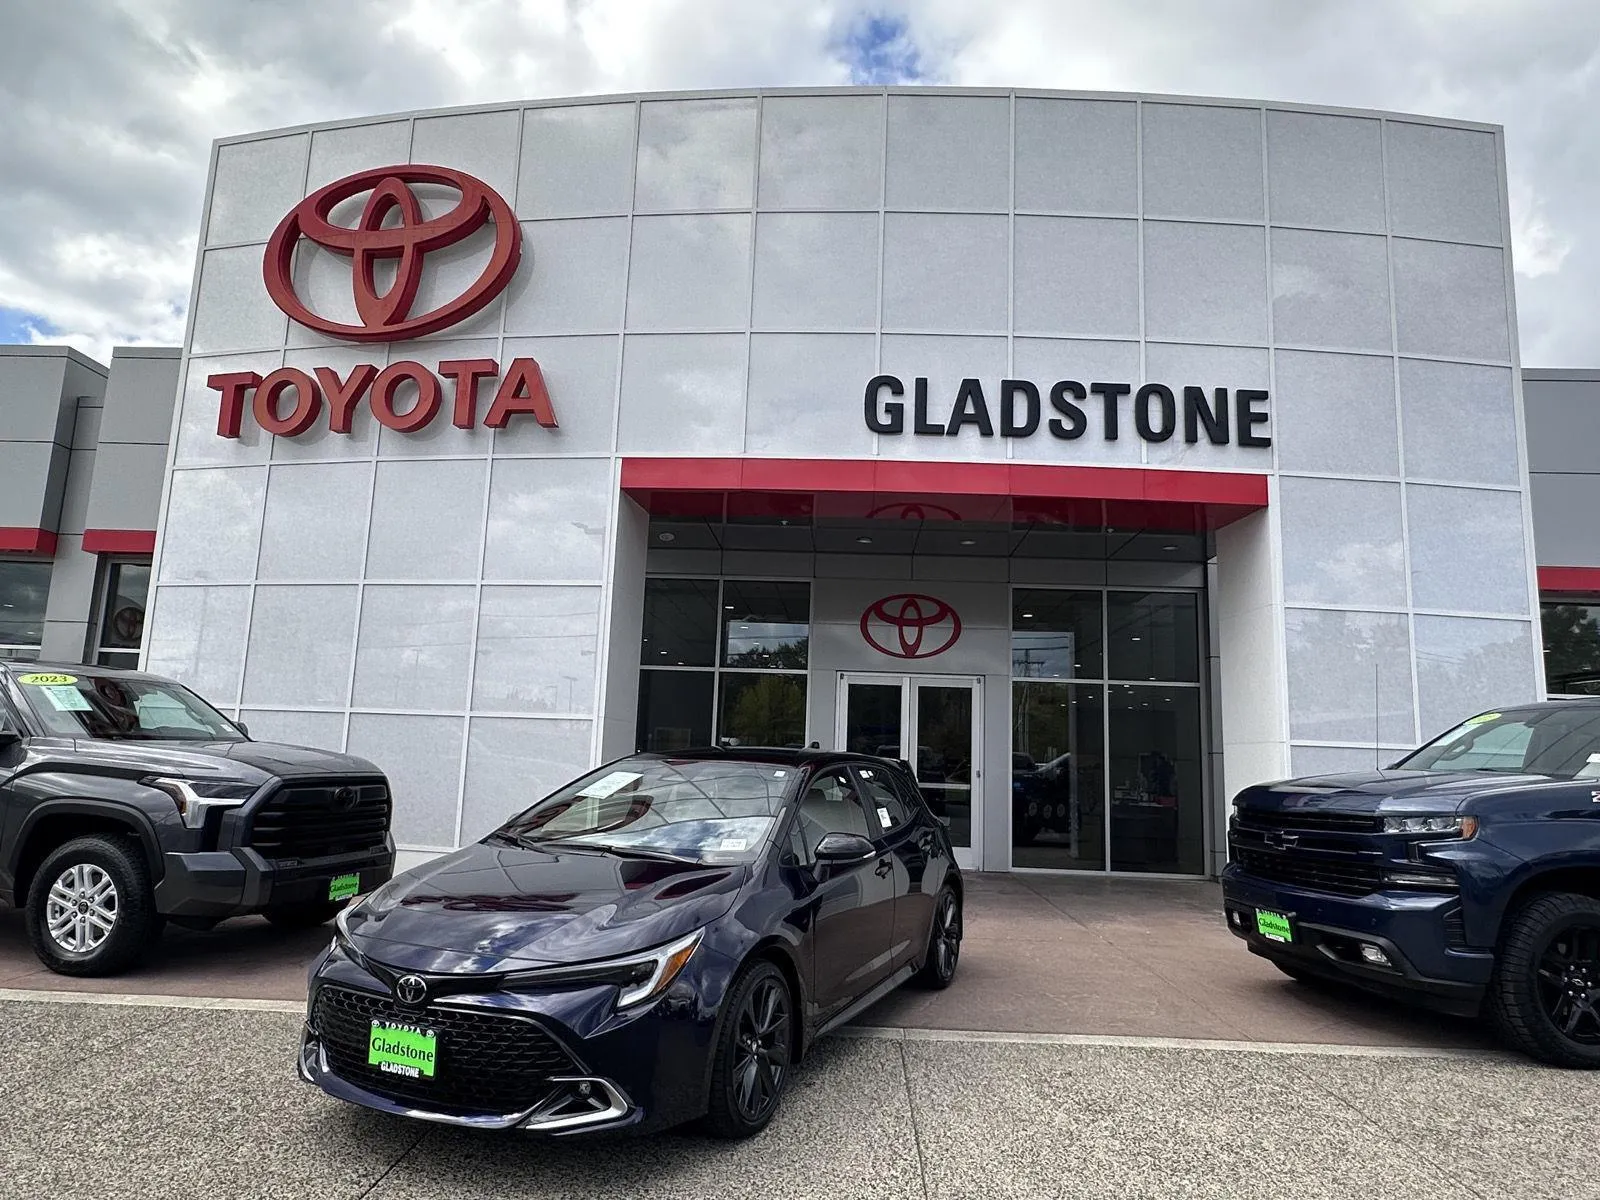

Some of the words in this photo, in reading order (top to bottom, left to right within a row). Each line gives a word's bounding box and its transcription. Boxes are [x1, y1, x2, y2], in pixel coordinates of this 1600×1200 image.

[207, 357, 559, 439] TOYOTA
[864, 374, 1272, 447] GLADSTONE
[30, 675, 68, 684] 2023
[385, 1021, 421, 1035] TOYOTA
[371, 1037, 434, 1063] Gladstone
[380, 1061, 420, 1078] GLADSTONE
